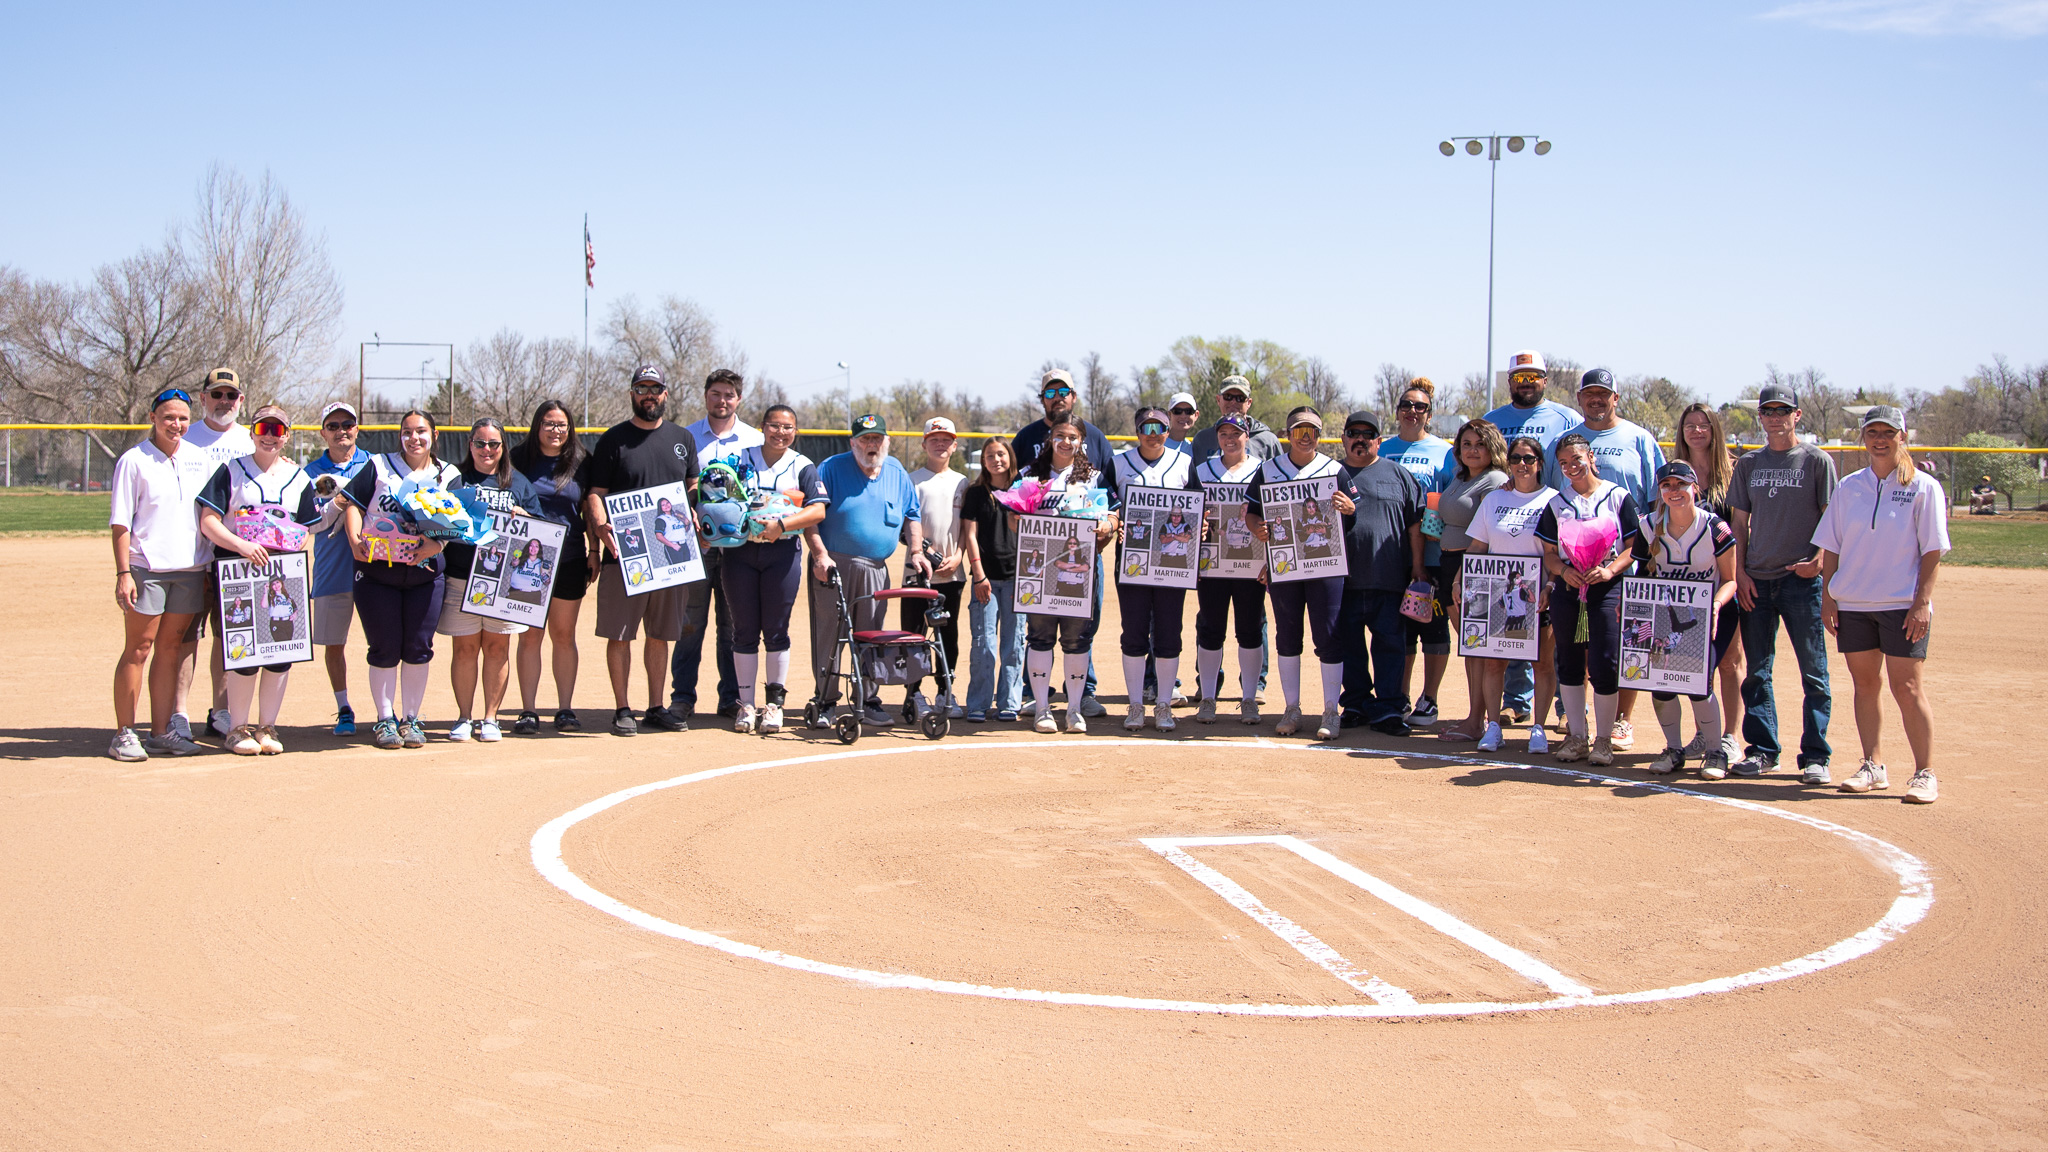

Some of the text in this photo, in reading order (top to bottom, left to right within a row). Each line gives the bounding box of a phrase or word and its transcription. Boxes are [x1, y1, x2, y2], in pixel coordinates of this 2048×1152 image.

[1591, 447, 1623, 456] TLERS
[1751, 468, 1804, 480] OTERO
[1750, 479, 1803, 488] SOFTBALL
[1262, 482, 1320, 503] DESTINY
[608, 492, 654, 515] KEIRA
[1129, 492, 1193, 509] ANGELYSE
[1021, 518, 1078, 538] MARIAH
[221, 559, 283, 580] ALYSON
[667, 565, 686, 575] GRAY
[1303, 559, 1338, 569] MARTINEZ
[1464, 558, 1525, 576] KAMRYN
[1154, 569, 1190, 579] MARTINEZ
[531, 578, 540, 587] 30
[1625, 581, 1697, 603] WHITNEY
[507, 602, 533, 614] GAMEZ
[1049, 598, 1082, 607] JOHNSON
[1507, 596, 1513, 610] 7
[260, 642, 305, 654] GREENLUND
[1498, 640, 1525, 649] FOSTER
[1663, 673, 1691, 683] BOONE
